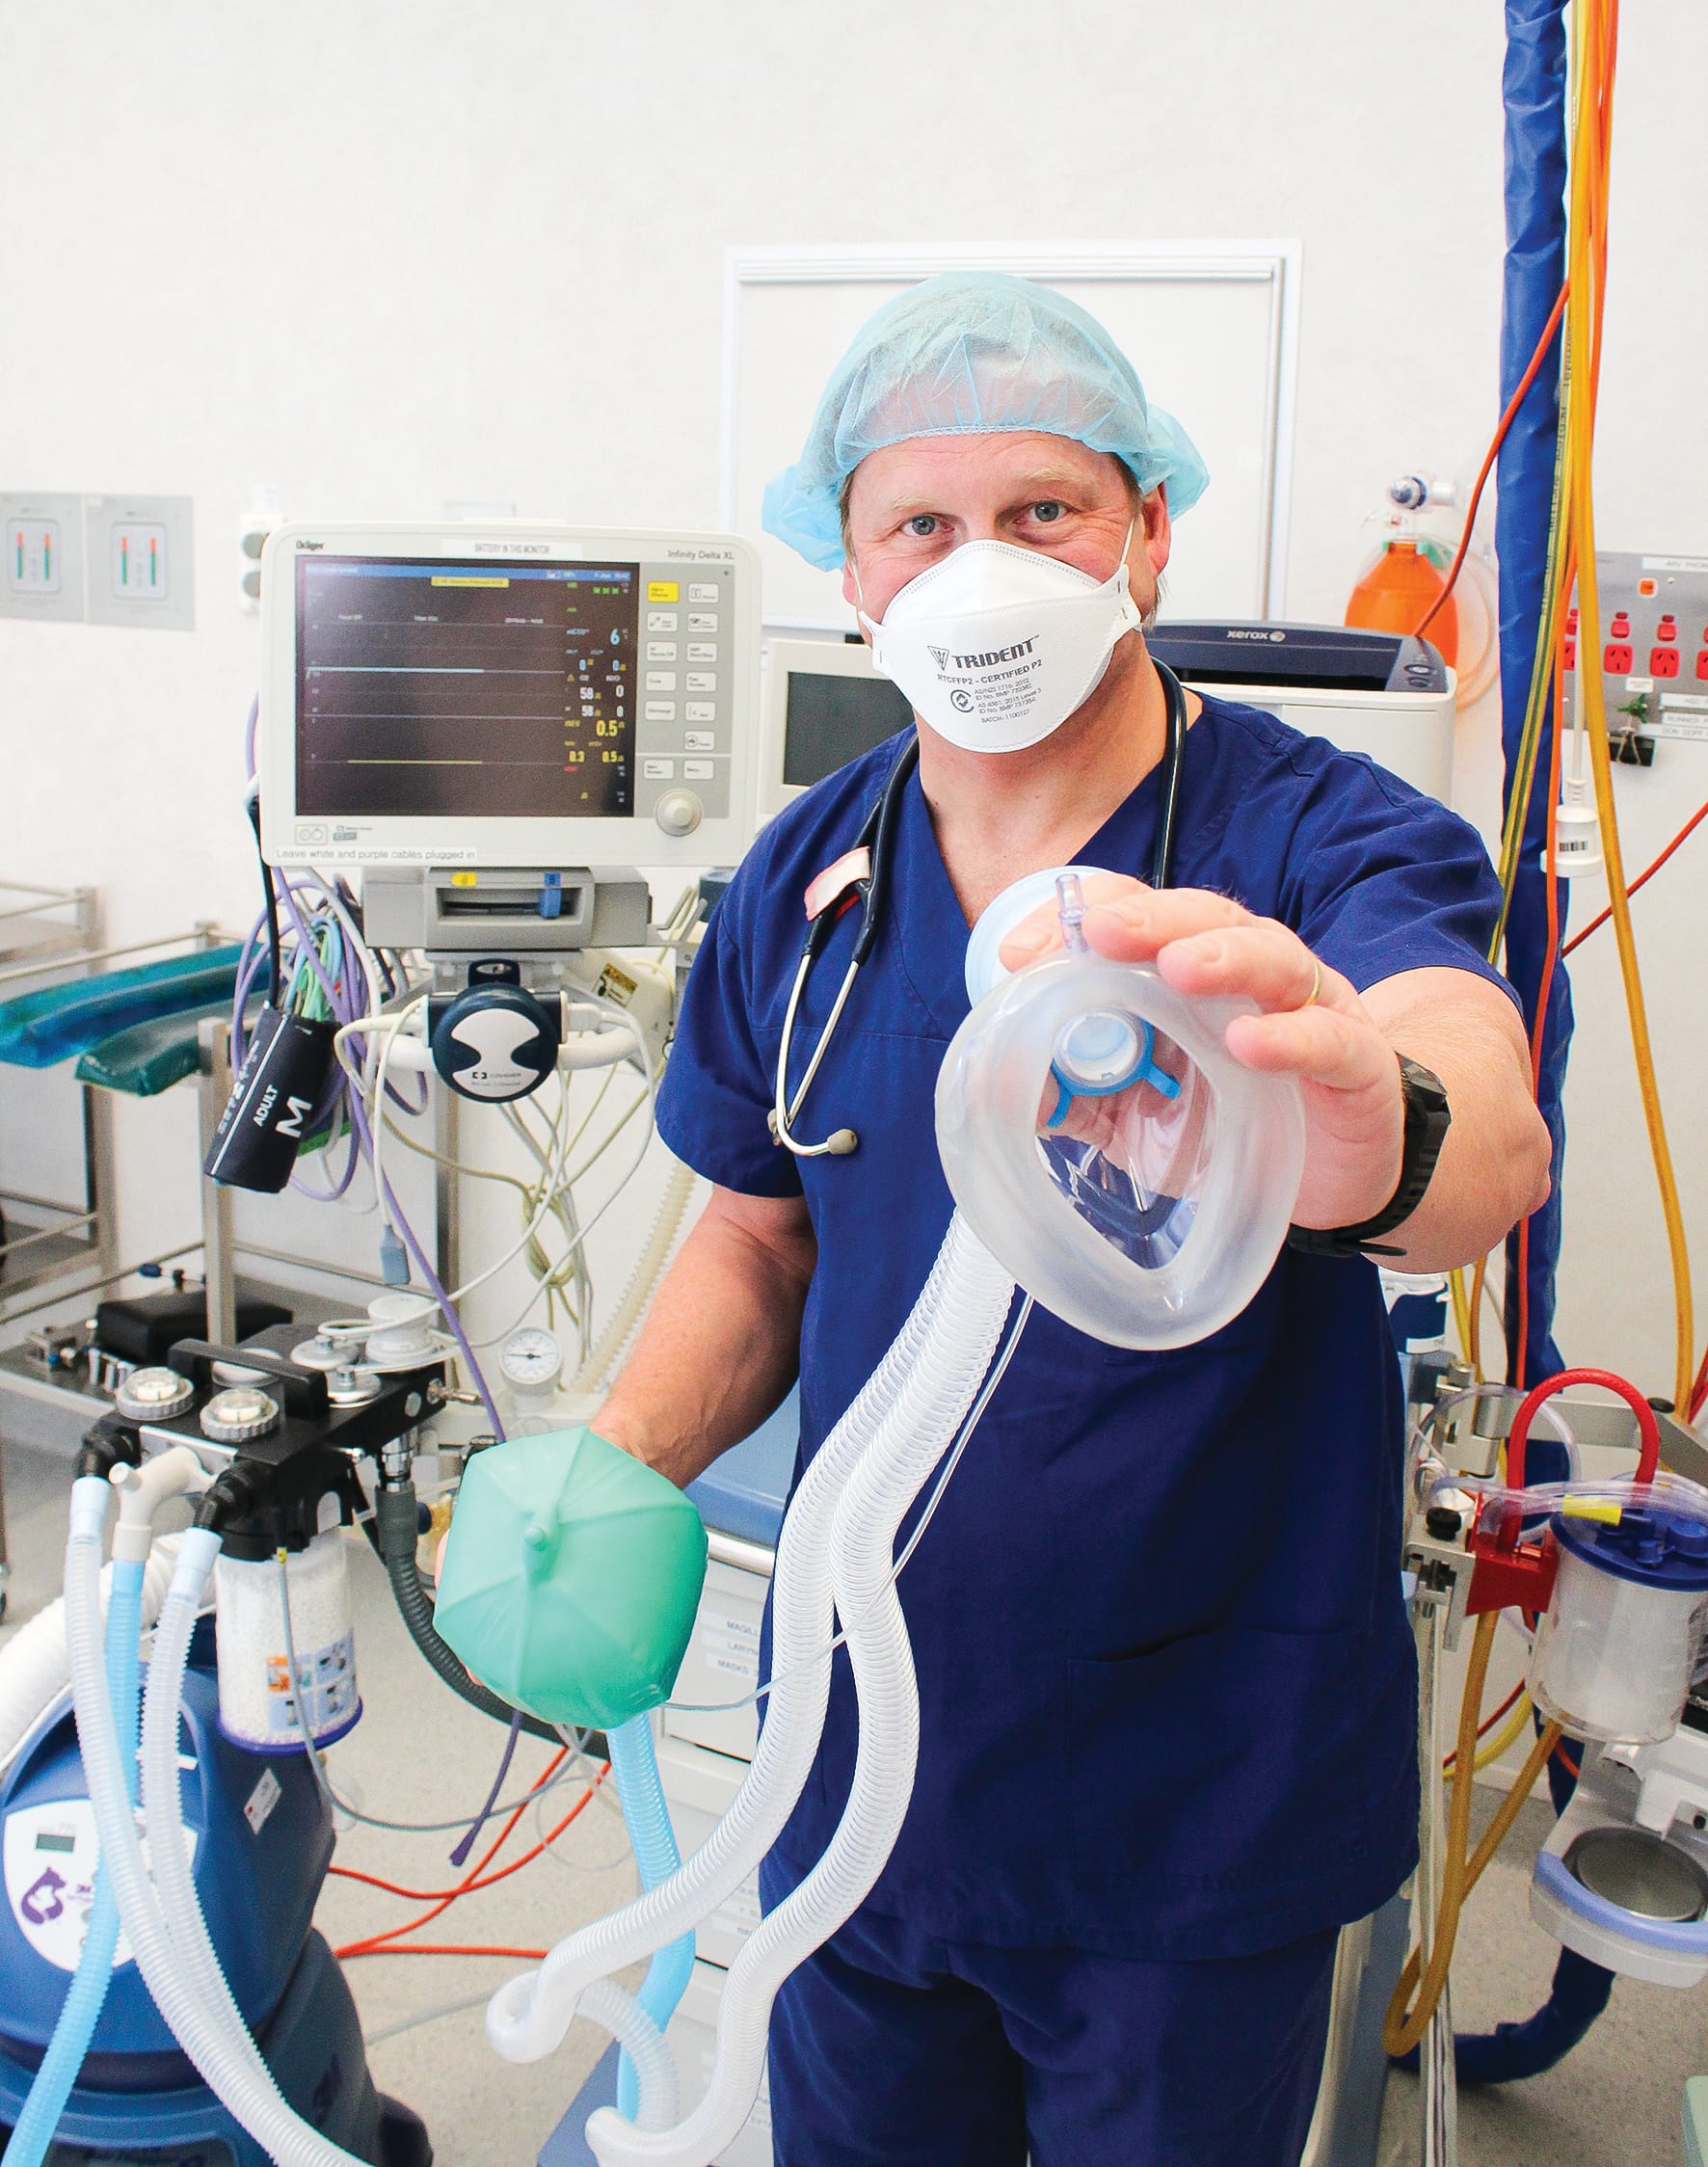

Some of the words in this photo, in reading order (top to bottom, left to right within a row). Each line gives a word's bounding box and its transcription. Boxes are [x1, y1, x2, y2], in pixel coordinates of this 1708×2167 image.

[698, 550, 721, 560] Delta
[610, 628, 620, 646] 6
[1226, 630, 1269, 640] xerox
[950, 637, 1034, 669] TRIDENT
[980, 665, 1030, 683] CERTIFIED
[1031, 659, 1042, 670] P2
[596, 719, 618, 737] 0.5
[276, 848, 307, 859] Leave
[308, 848, 334, 859] white
[336, 849, 356, 859] and
[358, 850, 388, 862] purple
[391, 849, 423, 859] cables
[425, 849, 464, 862] plugged
[466, 850, 475, 859] in
[253, 1084, 279, 1128] ADULT
[275, 1095, 313, 1138] M
